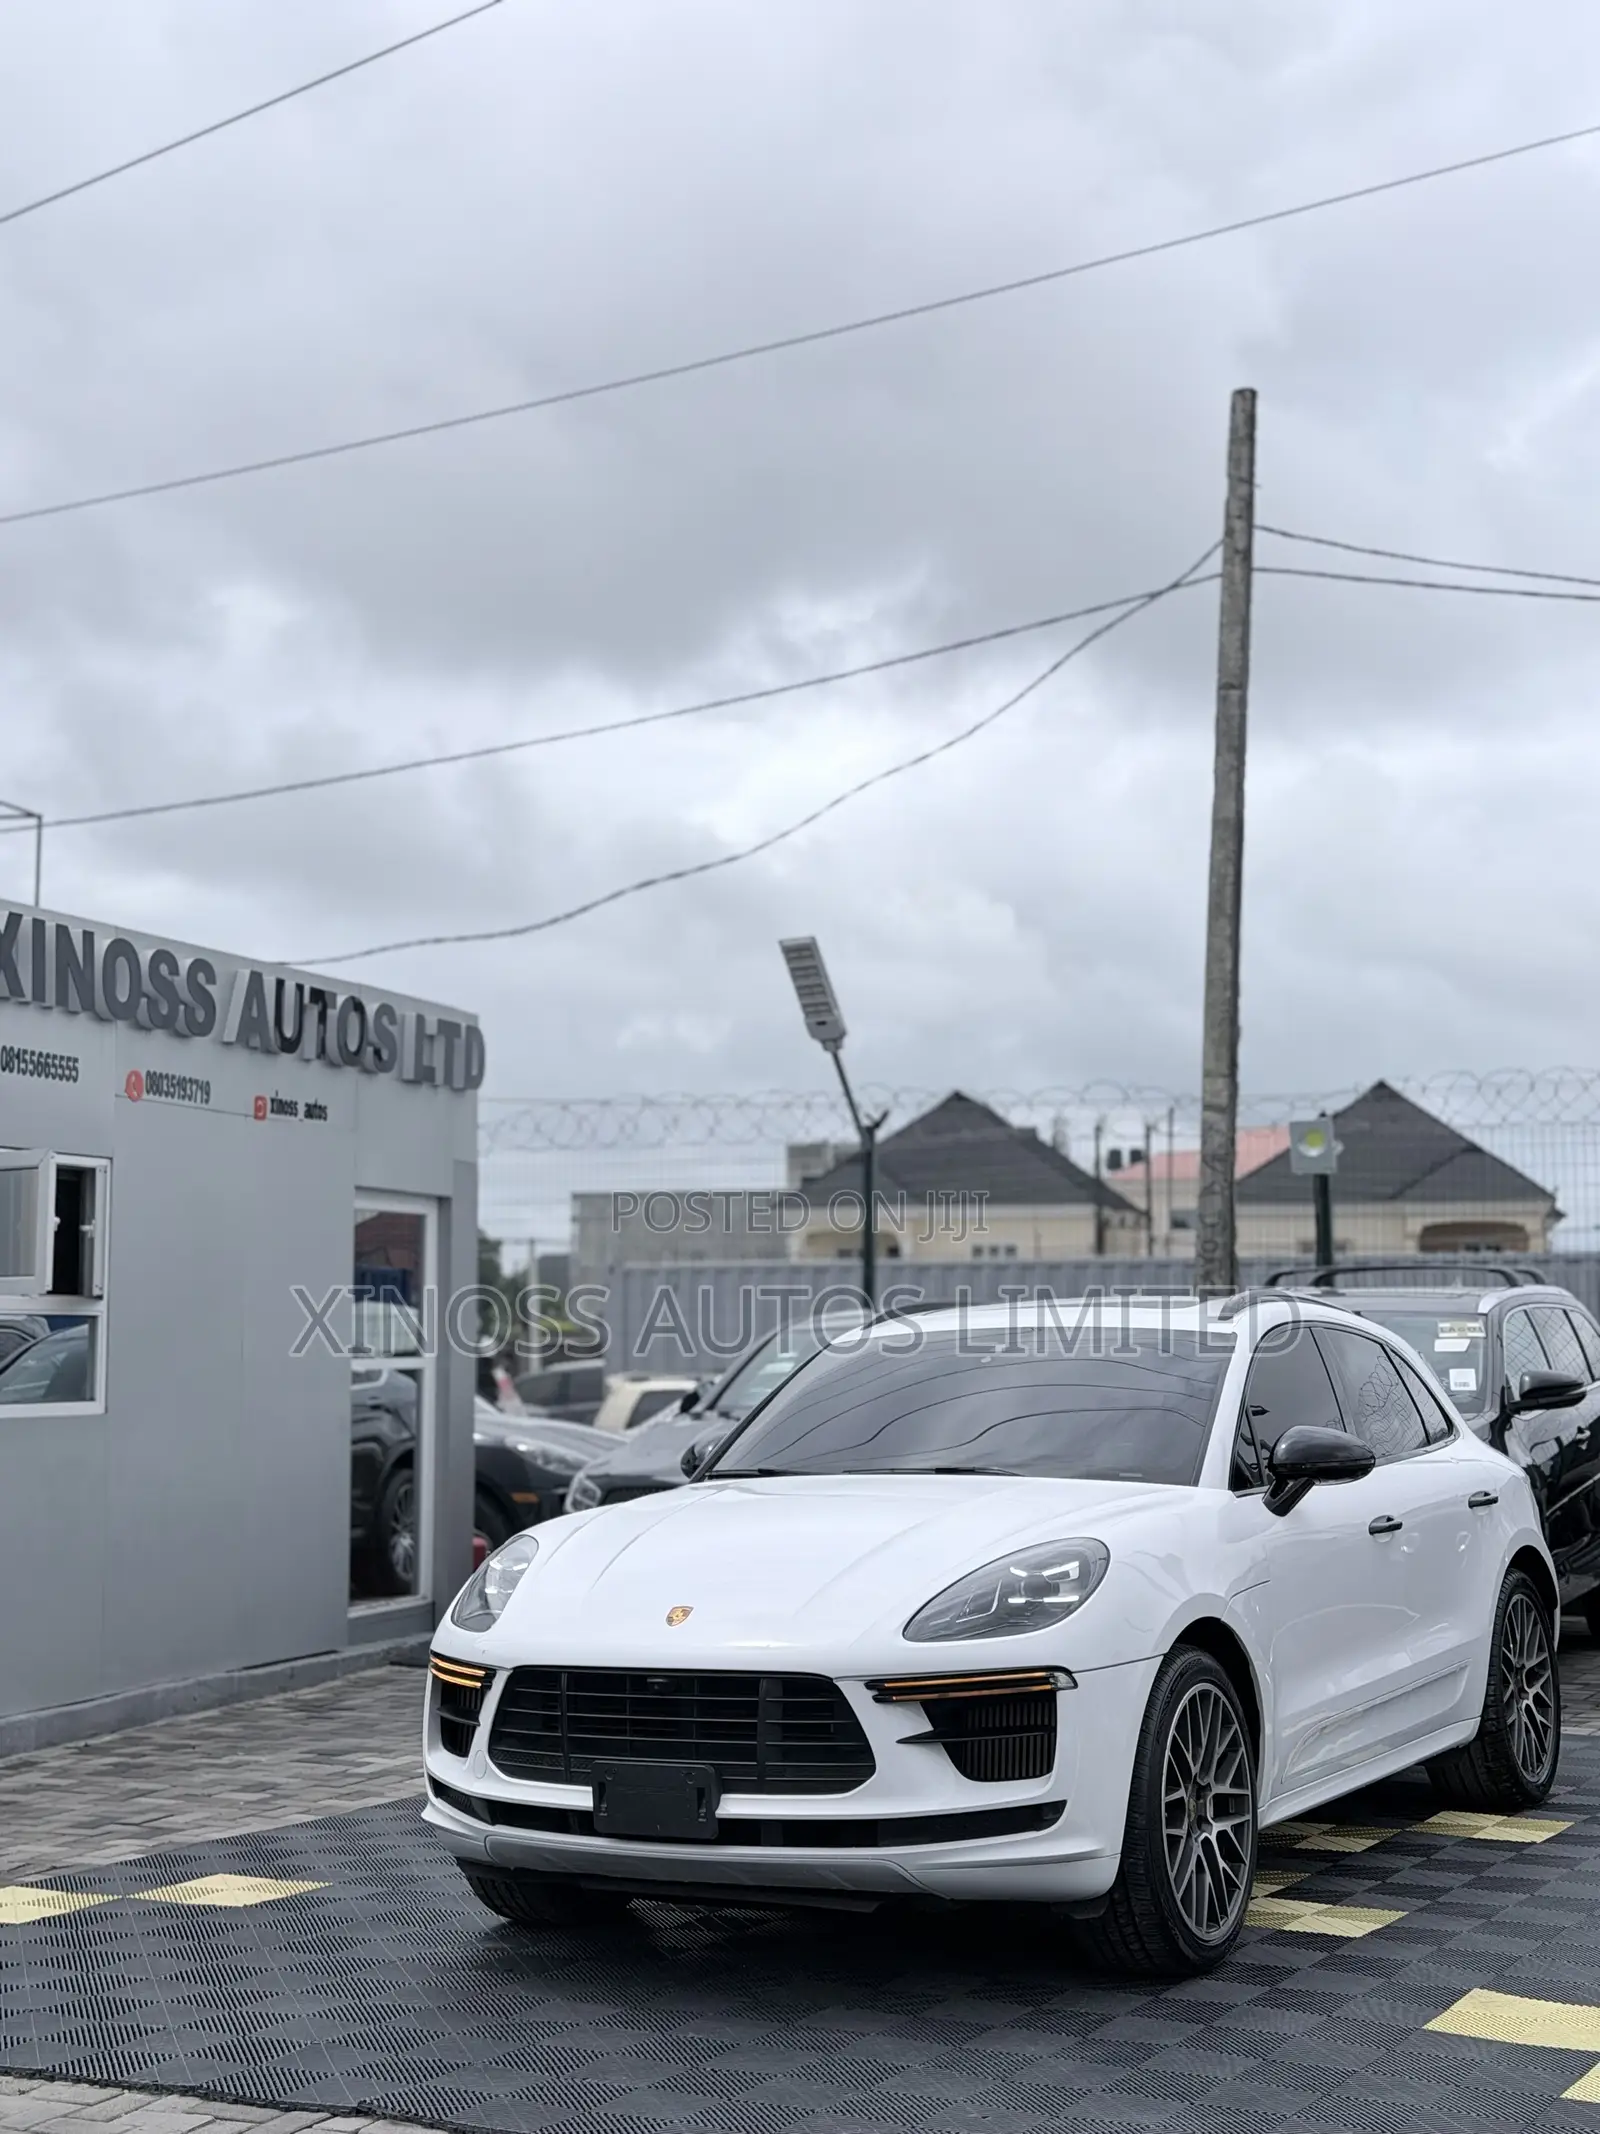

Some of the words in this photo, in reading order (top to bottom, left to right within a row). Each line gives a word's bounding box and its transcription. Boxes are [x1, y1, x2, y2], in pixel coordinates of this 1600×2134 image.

[0, 911, 216, 1037] XINOSS
[227, 970, 397, 1073] AUTOS
[407, 1013, 485, 1090] LTD
[0, 1045, 79, 1083] 08155665555
